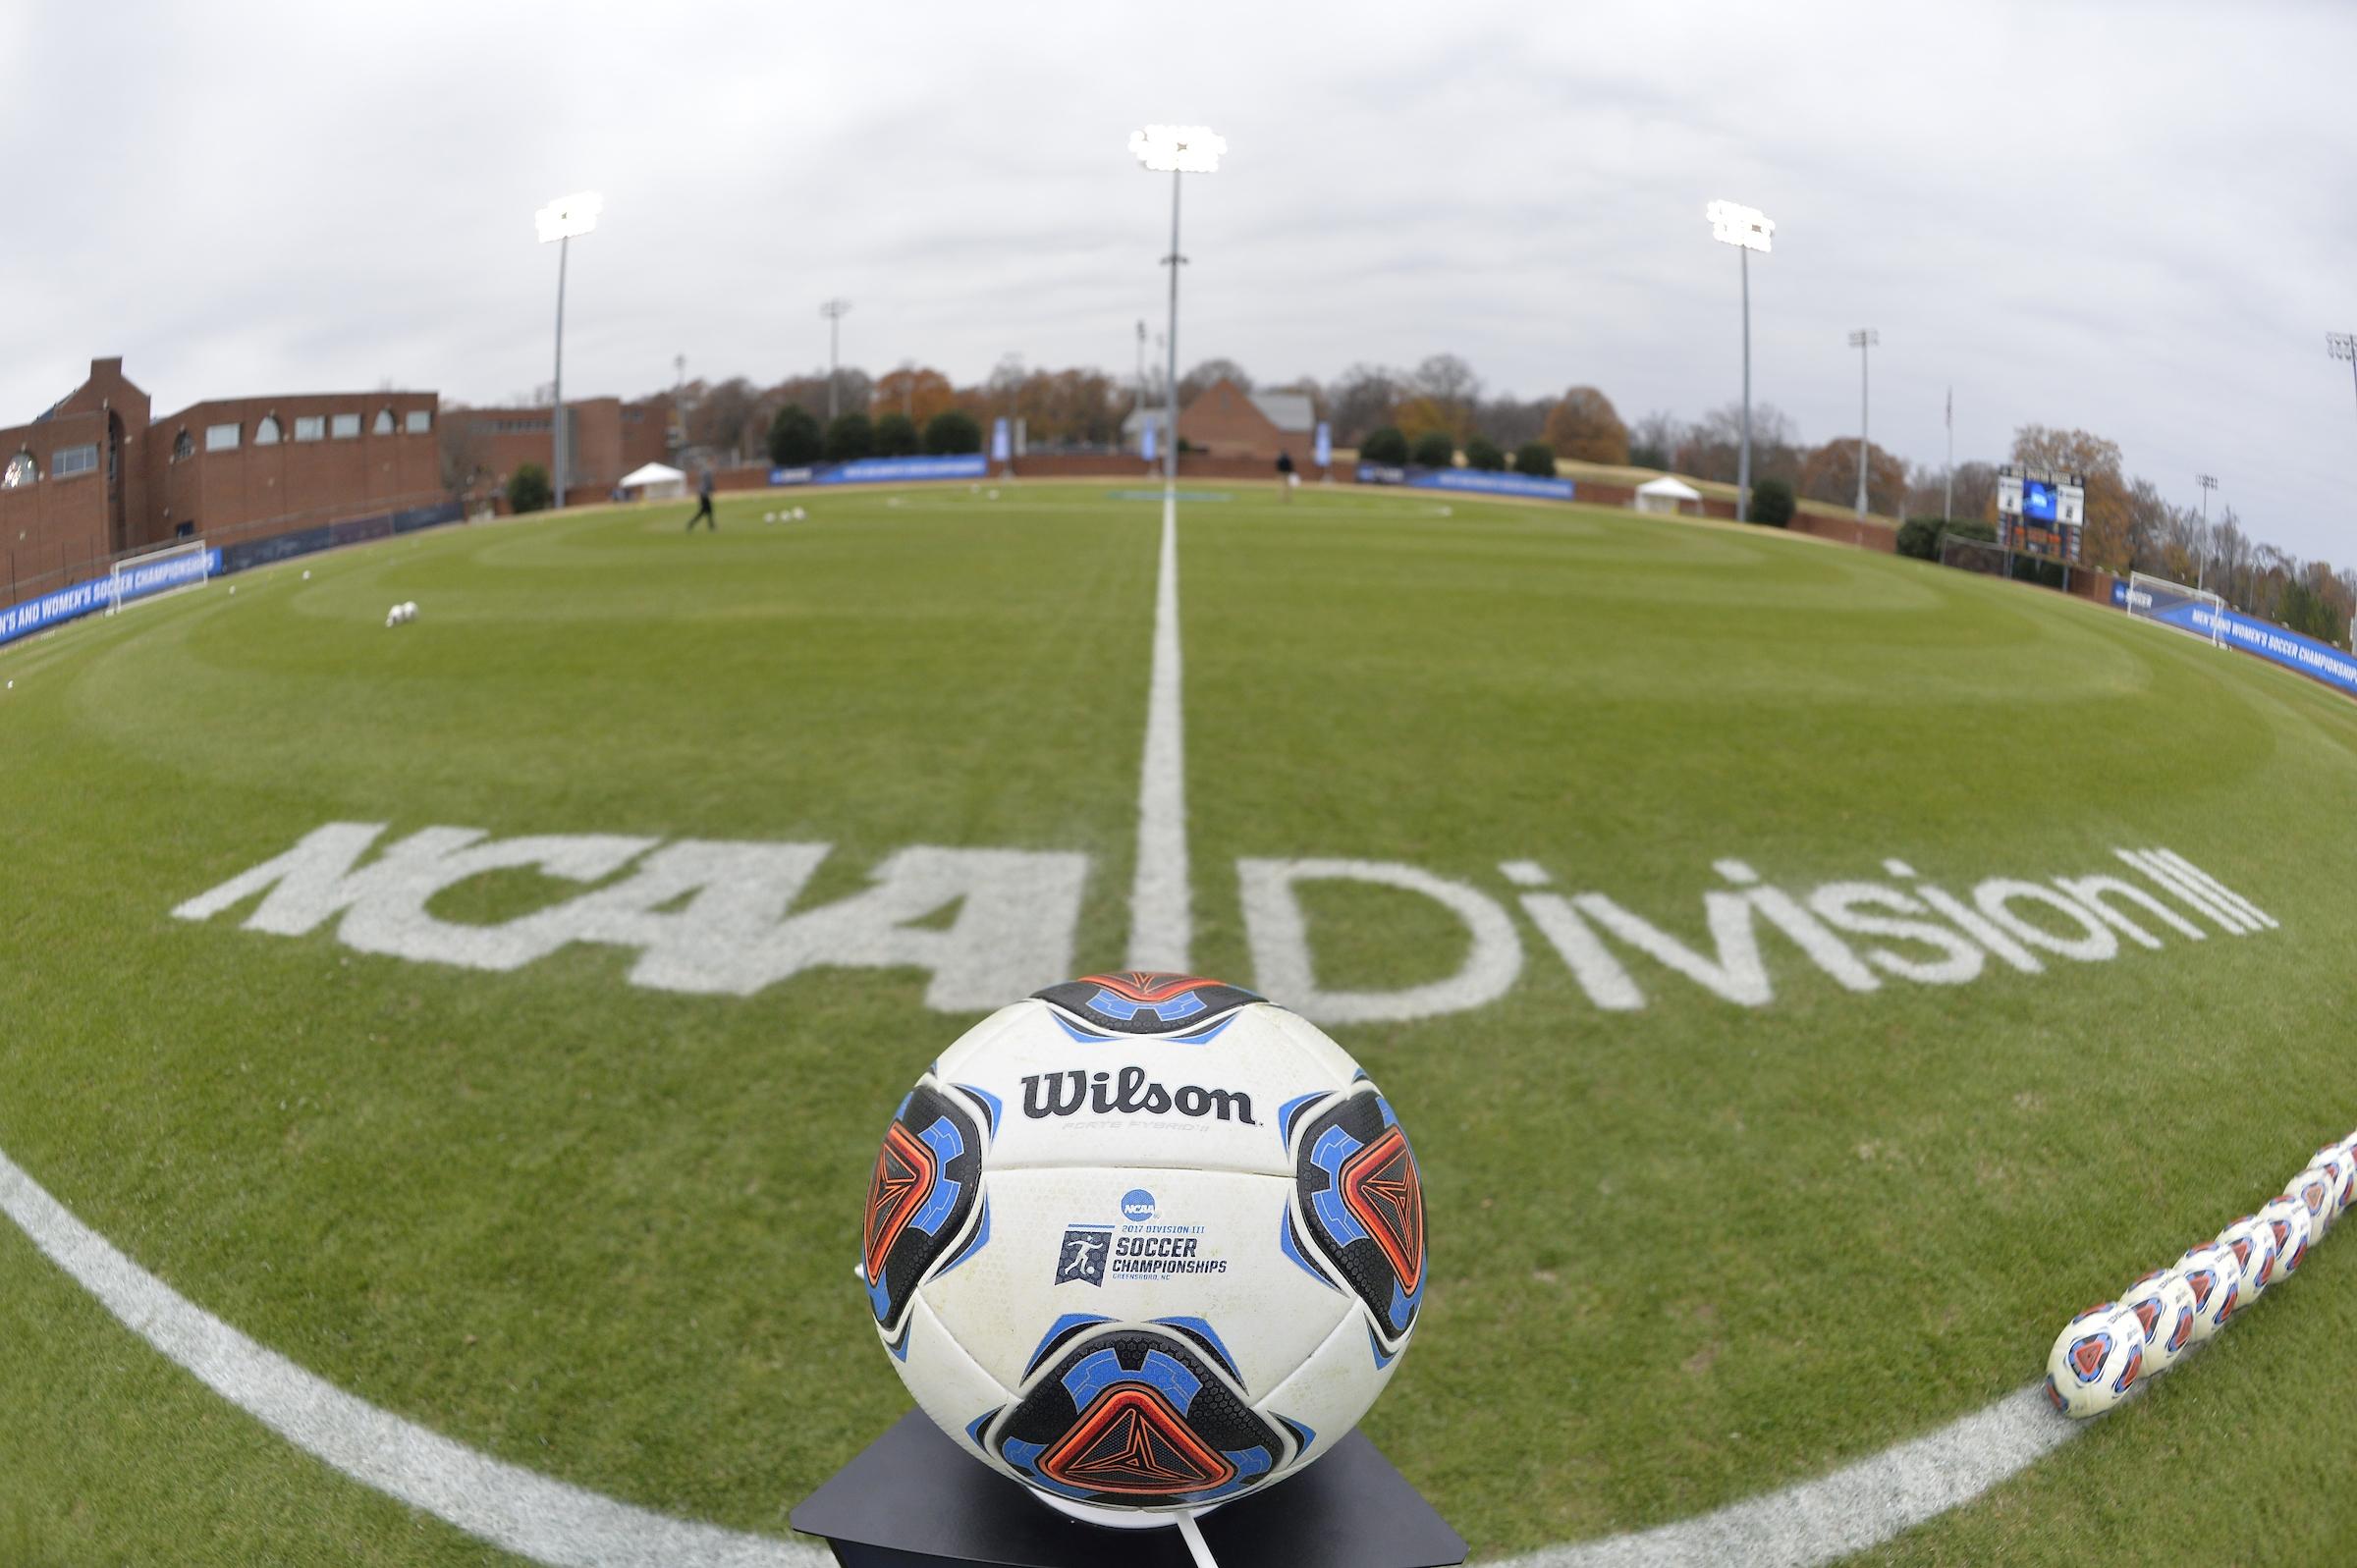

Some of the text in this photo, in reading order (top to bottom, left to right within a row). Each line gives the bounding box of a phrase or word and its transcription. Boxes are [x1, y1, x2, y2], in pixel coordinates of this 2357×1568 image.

[18, 602, 40, 629] AND
[42, 584, 92, 620] WOMEN'S
[2231, 621, 2269, 648] WOMEN'S
[2268, 634, 2299, 659] SOCCER
[171, 821, 1089, 1013] NCAA
[1021, 1066, 1257, 1126] Wilson
[1124, 1204, 1155, 1215] NCAA
[1122, 1224, 1144, 1233] 2017
[1146, 1225, 1189, 1234] DIVISION
[1115, 1237, 1198, 1258] SOCCER
[1112, 1259, 1228, 1273] CHAMPIONSHIPS
